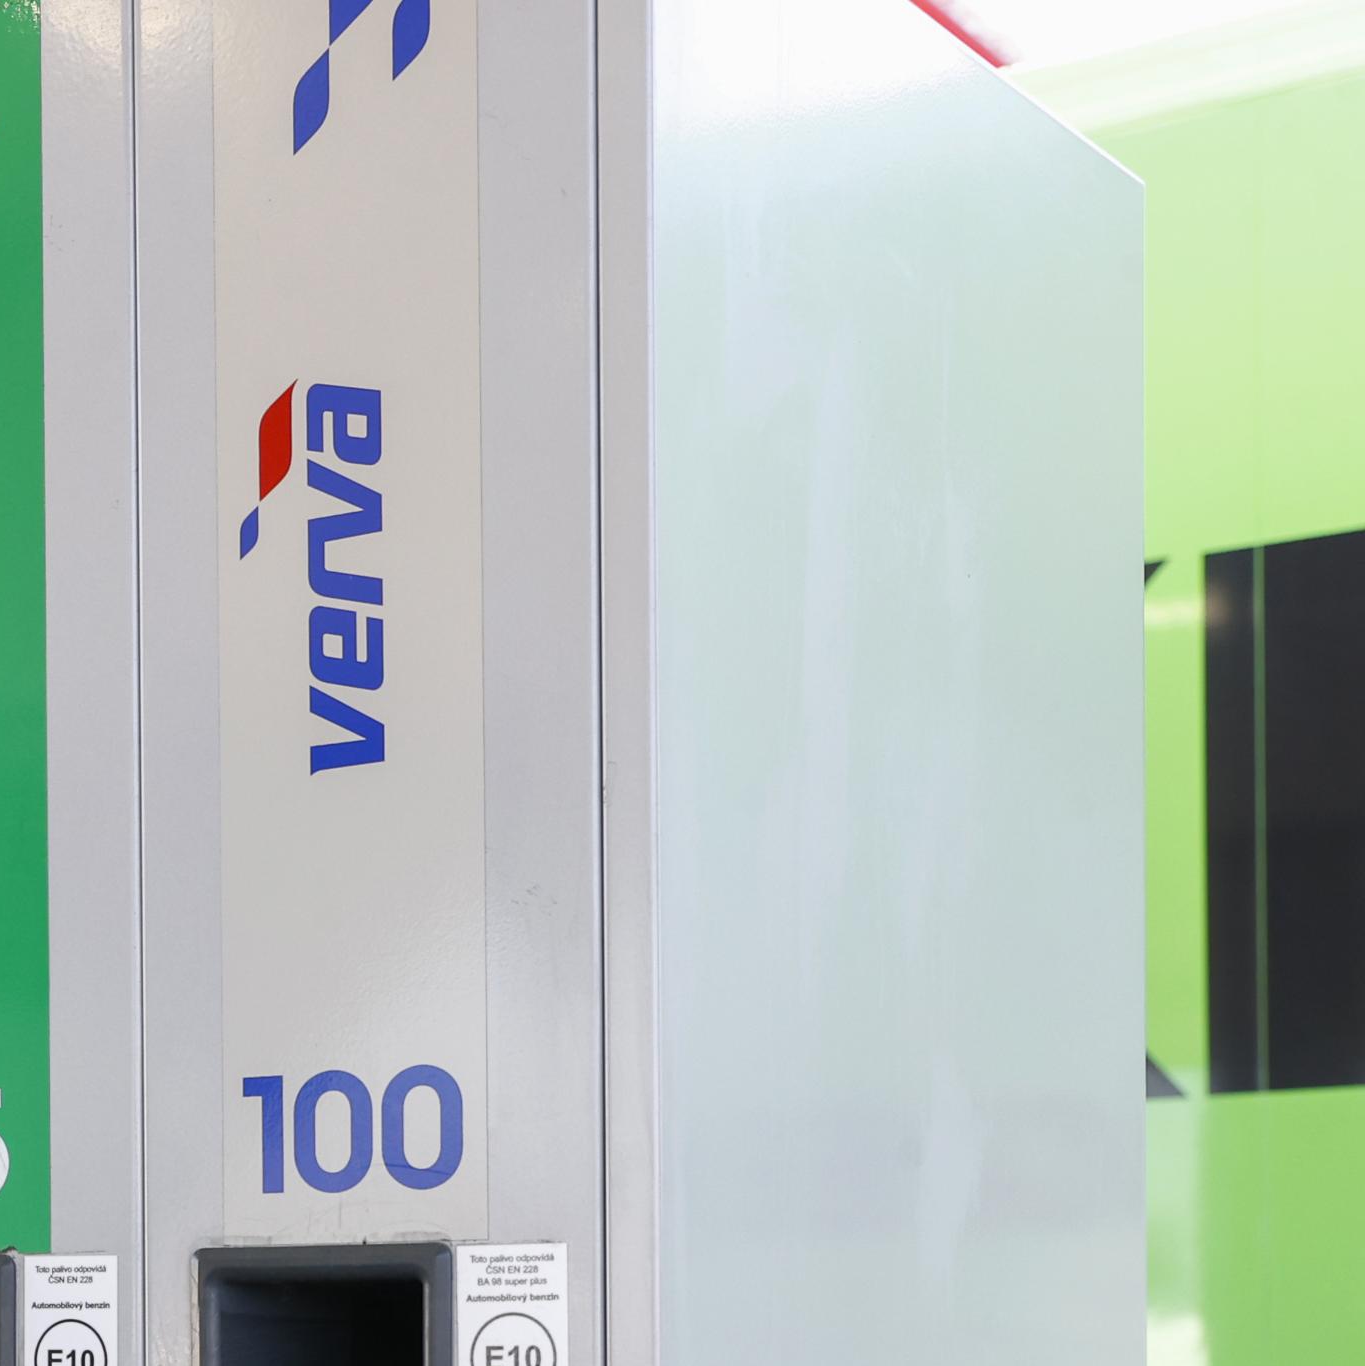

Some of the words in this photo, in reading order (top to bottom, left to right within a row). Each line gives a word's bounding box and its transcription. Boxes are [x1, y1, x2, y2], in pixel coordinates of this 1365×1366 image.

[306, 383, 385, 776] verva
[242, 1063, 464, 1195] 100
[470, 1255, 487, 1263] Toto
[490, 1255, 513, 1264] palivo
[516, 1254, 554, 1263] odpovídá
[52, 1266, 72, 1274] palivo
[74, 1265, 106, 1273] odpovídá
[486, 1265, 505, 1274] ČSN
[508, 1266, 520, 1274] EN
[48, 1274, 64, 1283] ČSN
[477, 1278, 489, 1286] BA
[530, 1277, 547, 1286] plus
[467, 1294, 526, 1303] Automobilový
[32, 1302, 83, 1310] Automobilový
